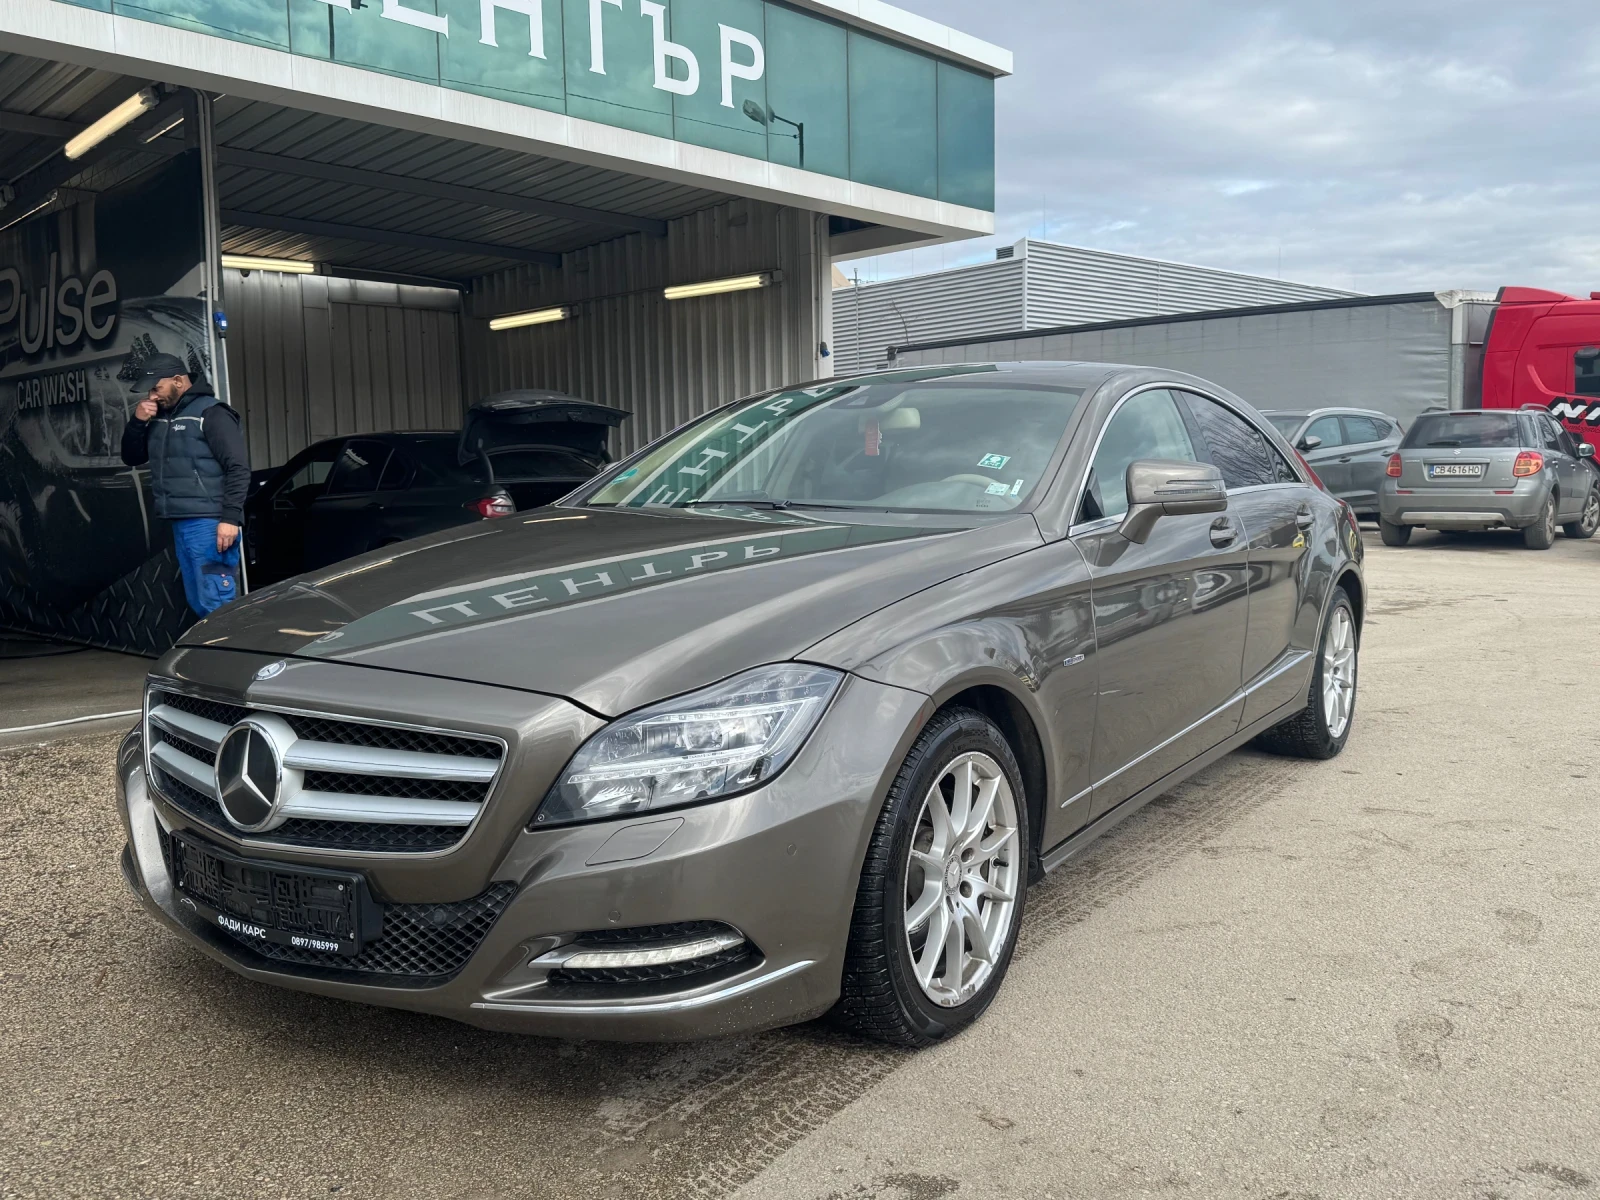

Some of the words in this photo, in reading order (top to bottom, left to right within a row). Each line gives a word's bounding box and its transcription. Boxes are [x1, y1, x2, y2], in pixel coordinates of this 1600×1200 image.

[17, 376, 42, 410] CAR
[44, 369, 87, 406] WASH
[1447, 466, 1467, 474] 4616
[218, 915, 241, 932] ФАДИ
[242, 923, 267, 939] КАРС
[291, 936, 339, 952] 0897/985999
